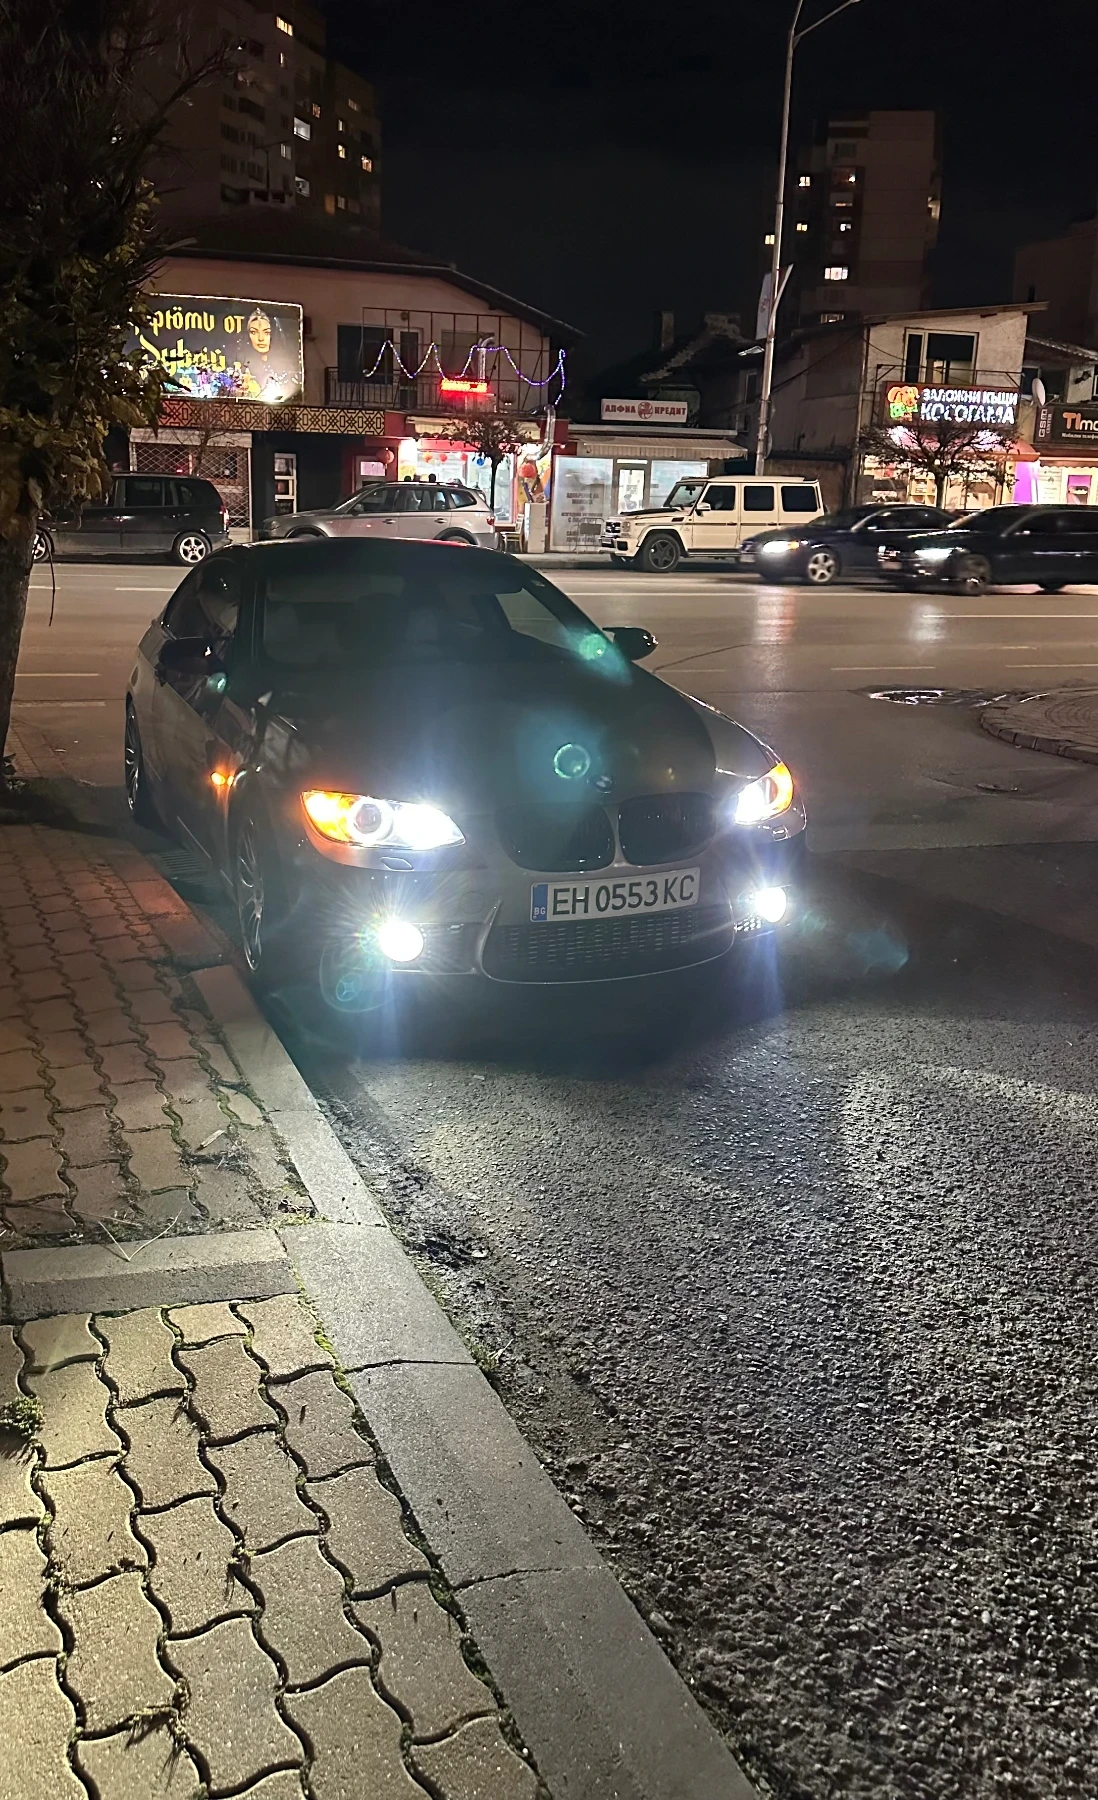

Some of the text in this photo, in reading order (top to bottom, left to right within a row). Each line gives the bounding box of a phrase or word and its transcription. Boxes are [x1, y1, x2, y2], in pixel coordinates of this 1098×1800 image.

[922, 387, 1018, 406] ЗАЛОЖНИ КЪЩИ
[654, 406, 686, 416] КРЕДИТ
[552, 875, 695, 915] EH 0553 KC
[533, 907, 546, 916] BG
